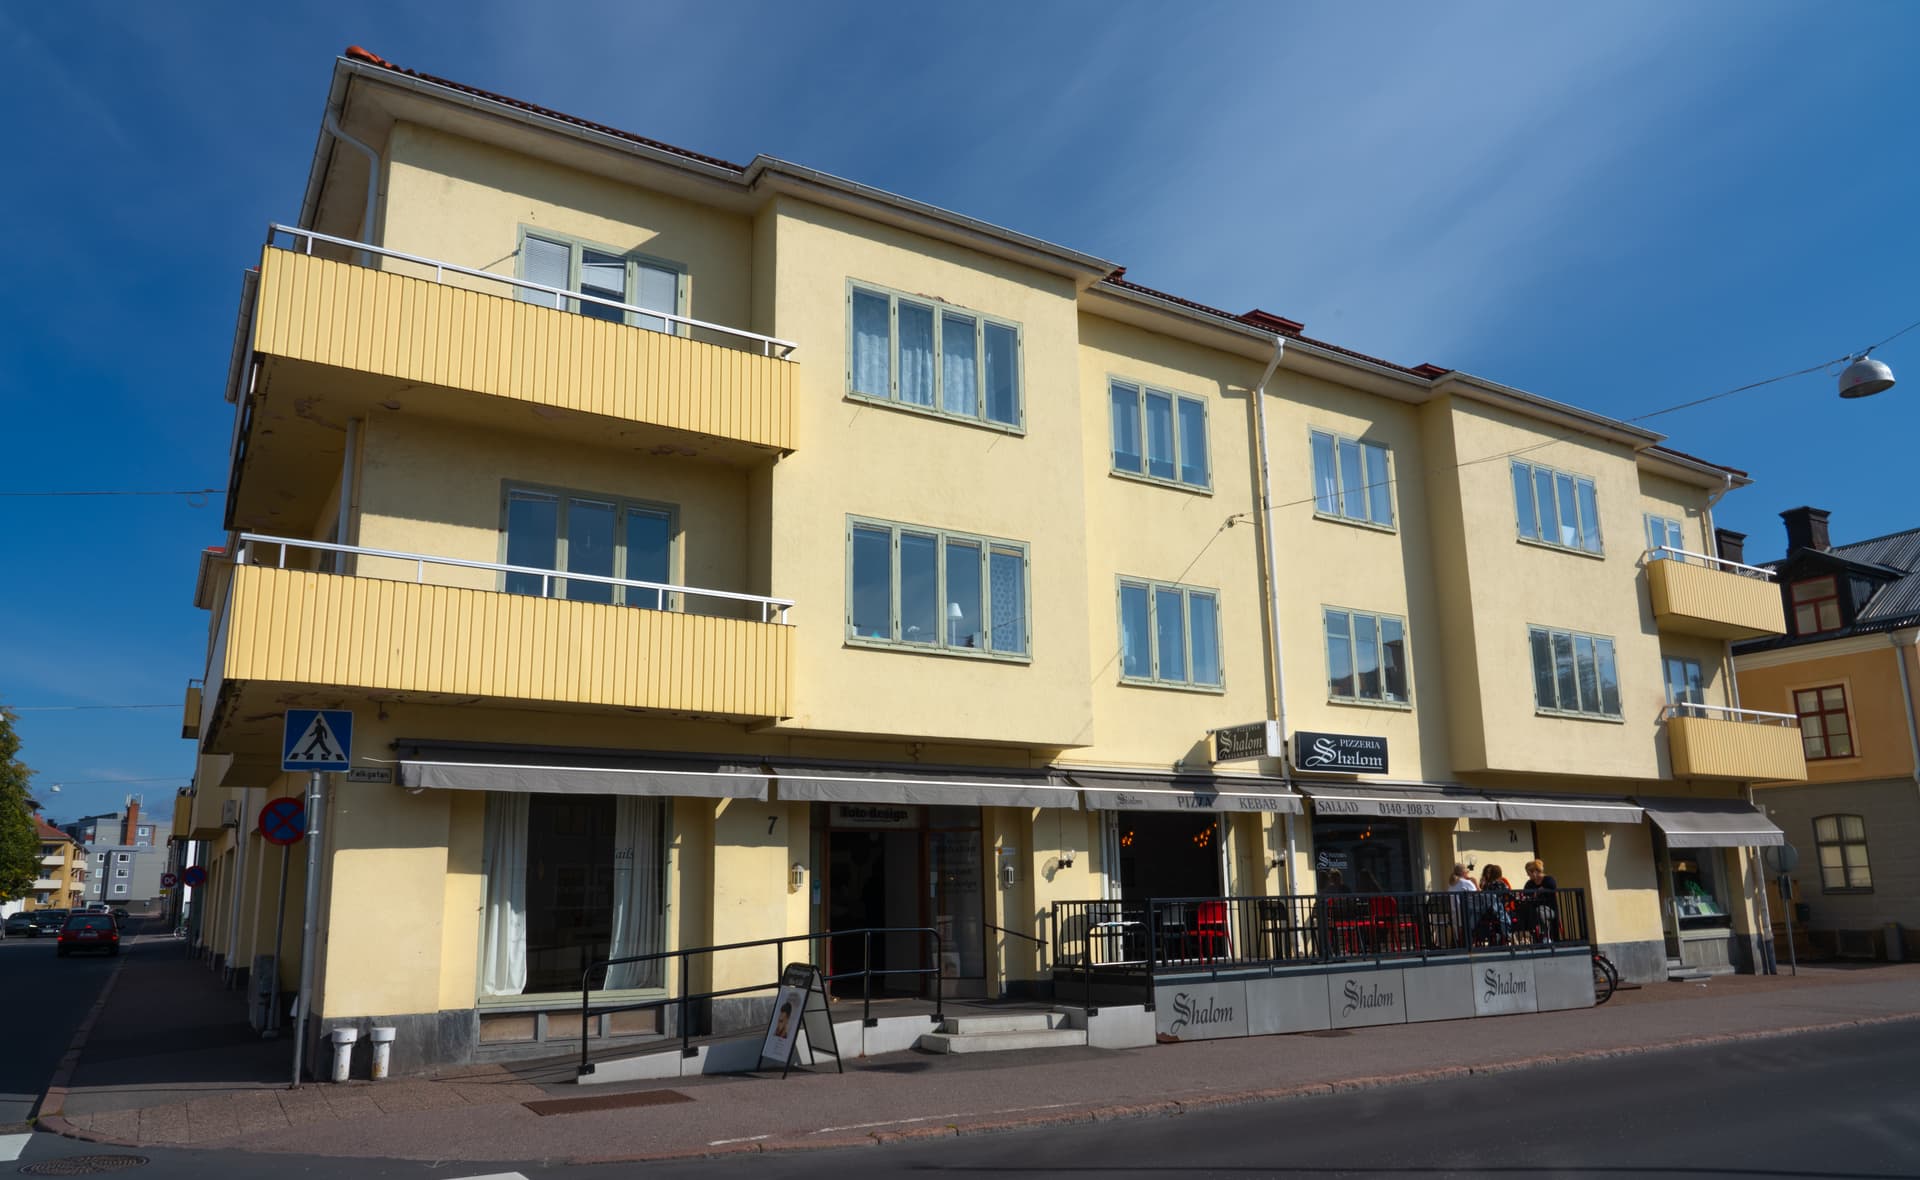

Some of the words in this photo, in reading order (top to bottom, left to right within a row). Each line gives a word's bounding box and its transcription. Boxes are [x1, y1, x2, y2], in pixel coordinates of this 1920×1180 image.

[1218, 729, 1263, 760] Shalom
[1305, 737, 1383, 767] Shalom
[1339, 738, 1381, 750] PIZZERIA
[1177, 796, 1214, 809] PIZZA
[1239, 797, 1278, 810] KEBAB
[1318, 801, 1359, 813] SALLAD
[1379, 802, 1422, 815] 0140-108
[1425, 803, 1436, 815] 33
[767, 815, 778, 835] 7
[1508, 829, 1518, 844] 7A
[1484, 968, 1527, 1003] Shalom
[1342, 979, 1393, 1018] Shalom
[1170, 992, 1233, 1035] Shalom
